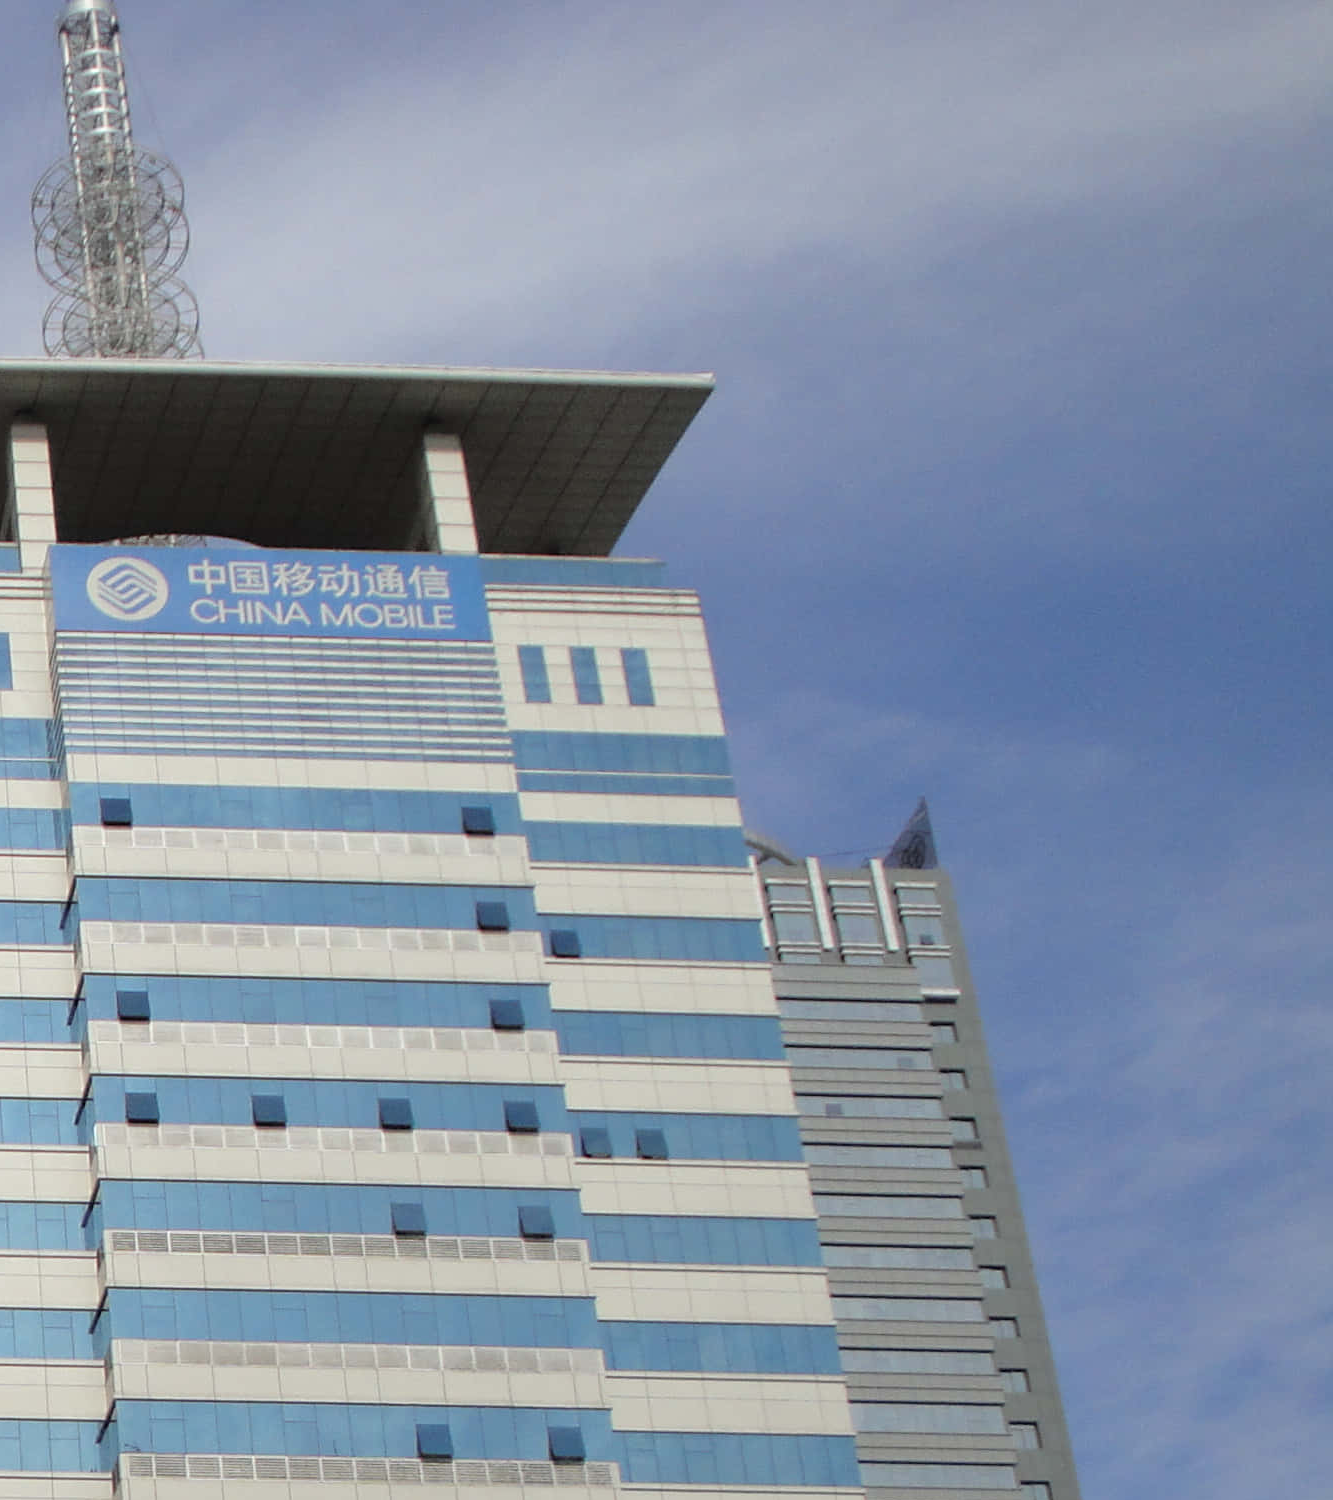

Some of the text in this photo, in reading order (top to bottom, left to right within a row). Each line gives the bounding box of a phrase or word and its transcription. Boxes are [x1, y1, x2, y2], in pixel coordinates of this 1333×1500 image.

[187, 558, 451, 599] 中国移动通信
[190, 598, 456, 630] CHINA MOBILE
